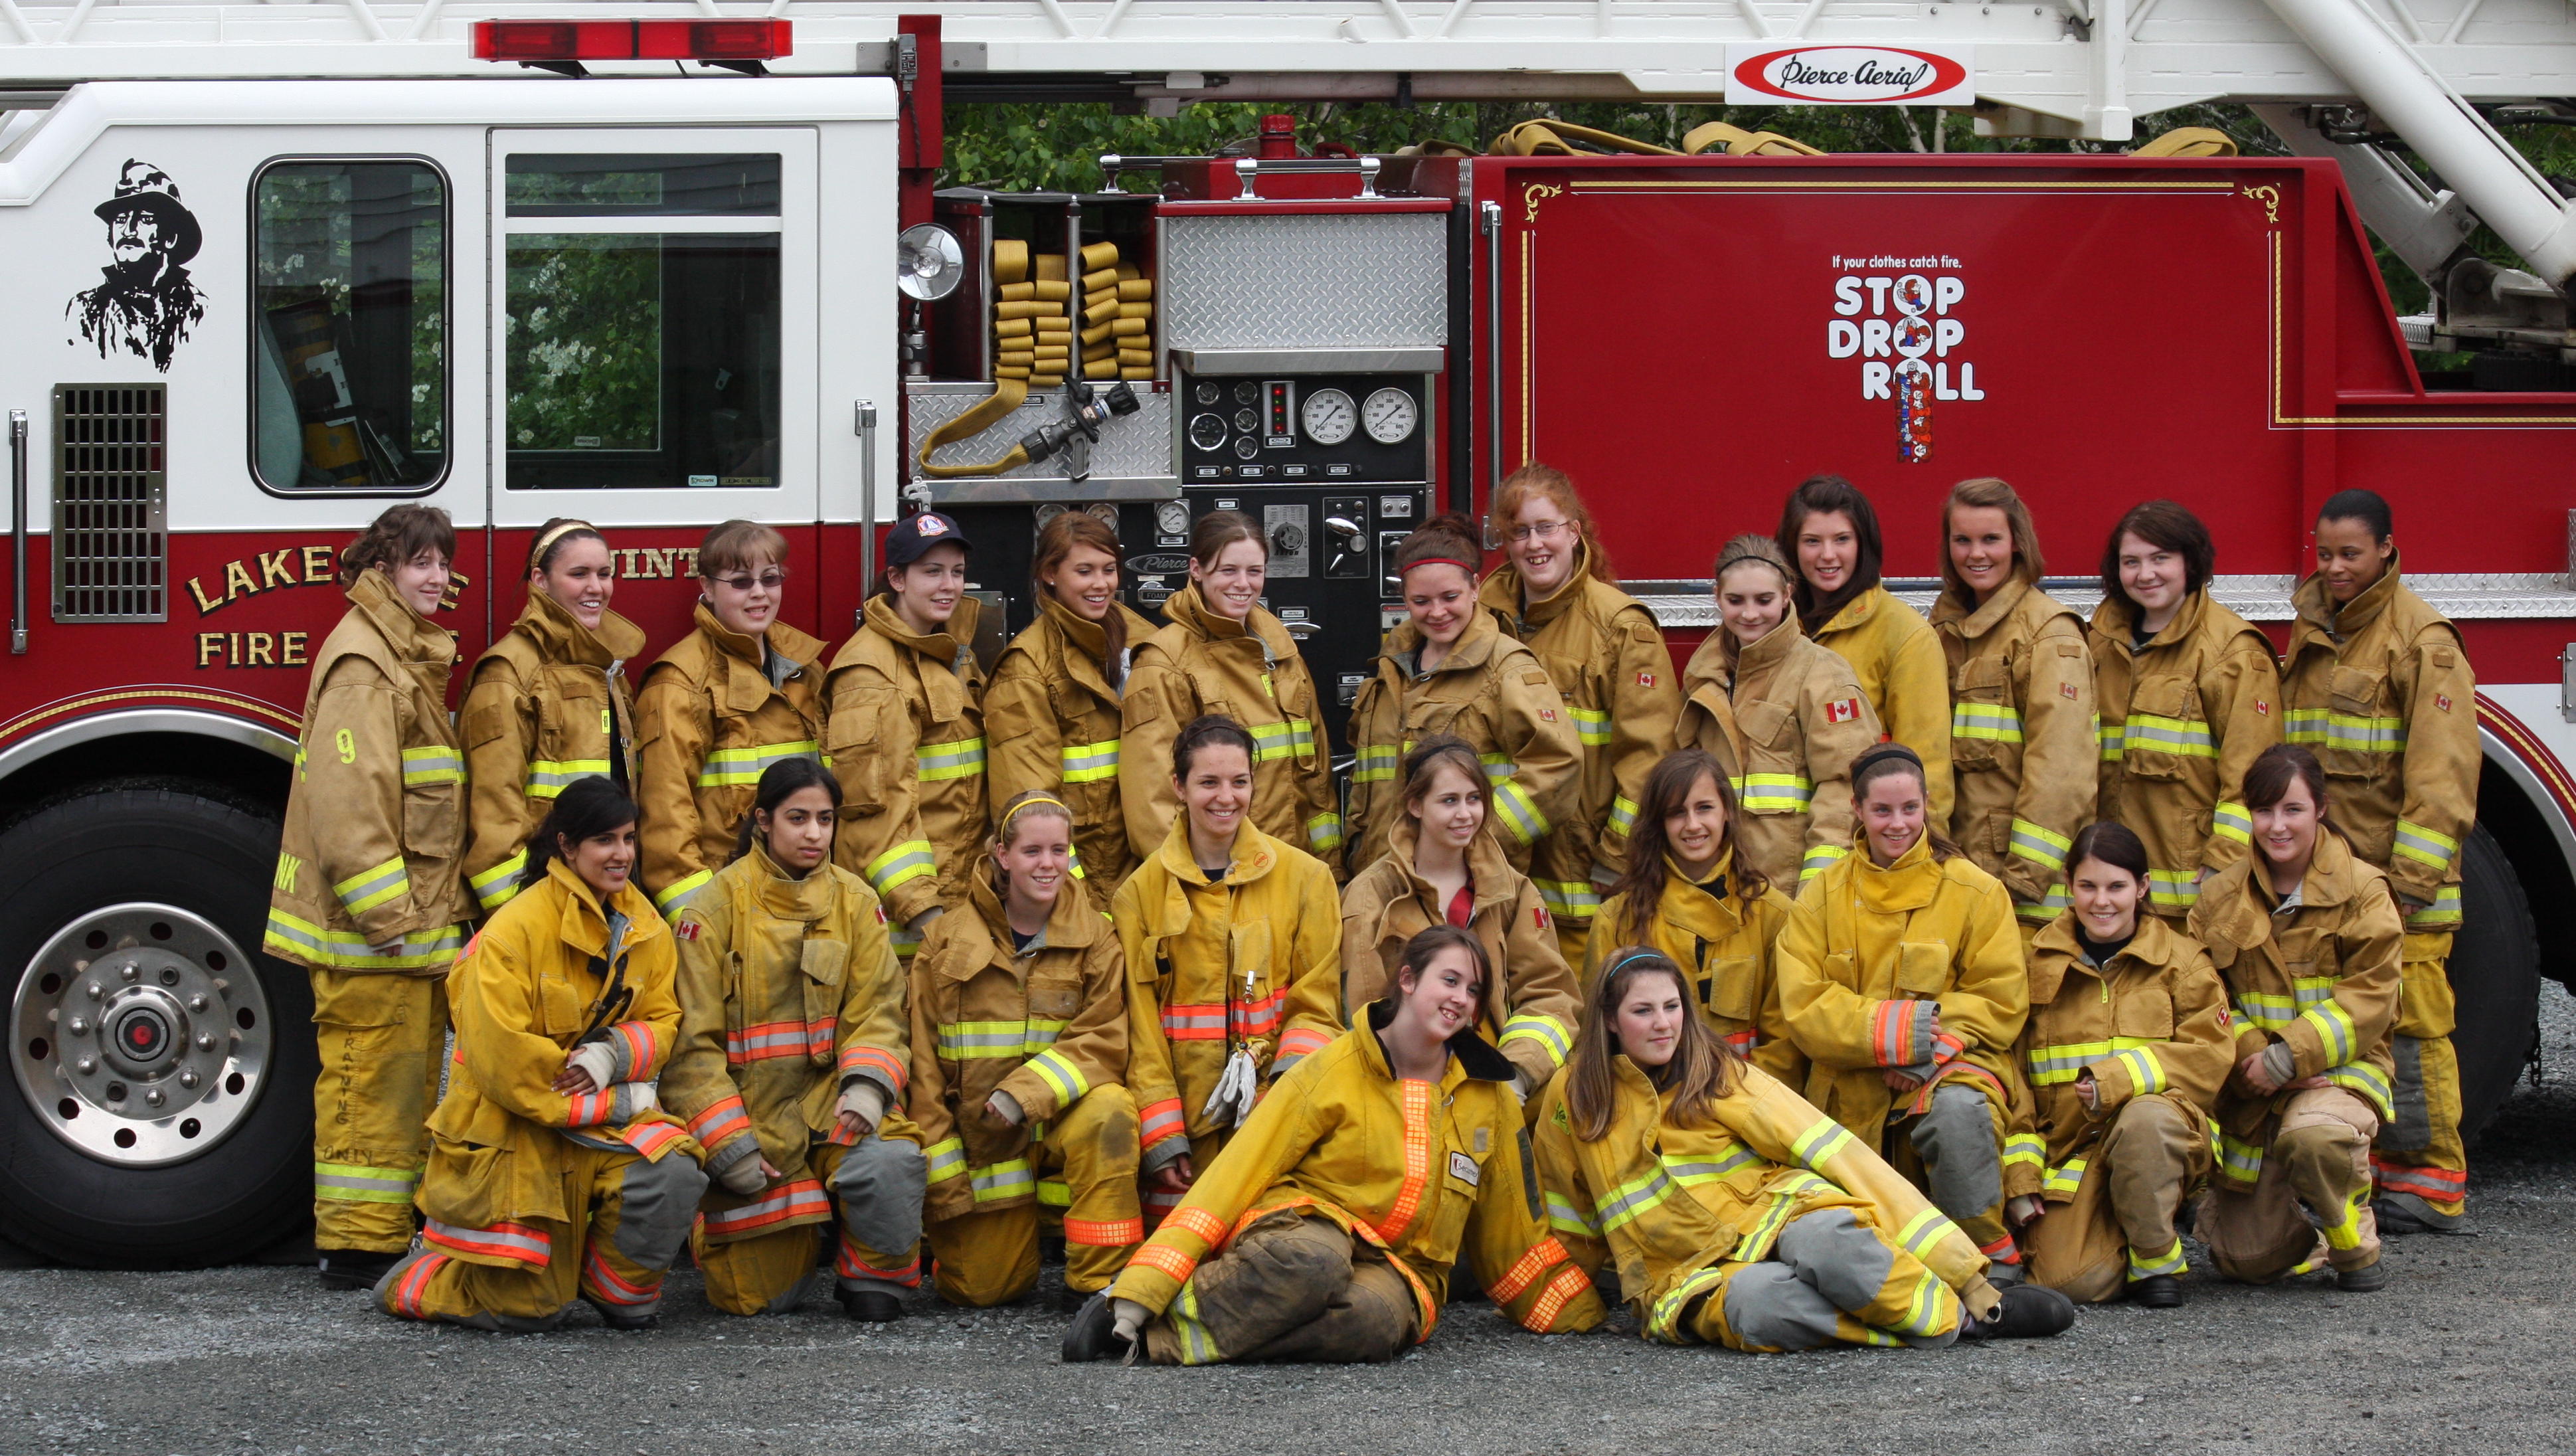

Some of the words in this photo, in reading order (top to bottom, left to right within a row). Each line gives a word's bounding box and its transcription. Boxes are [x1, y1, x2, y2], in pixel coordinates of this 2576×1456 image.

[1832, 255, 1840, 268] If
[1844, 258, 1865, 271] your
[1869, 255, 1907, 268] clothes
[1909, 255, 1938, 268] catch
[1940, 255, 1962, 268] fire.
[1834, 274, 1964, 316] STOP
[1828, 316, 1964, 359] DROP
[1863, 358, 1985, 401] ROLL
[1144, 557, 1188, 571] Pierce
[199, 632, 308, 665] FIRE
[336, 728, 356, 764] 9
[323, 1145, 373, 1166] ONLY
